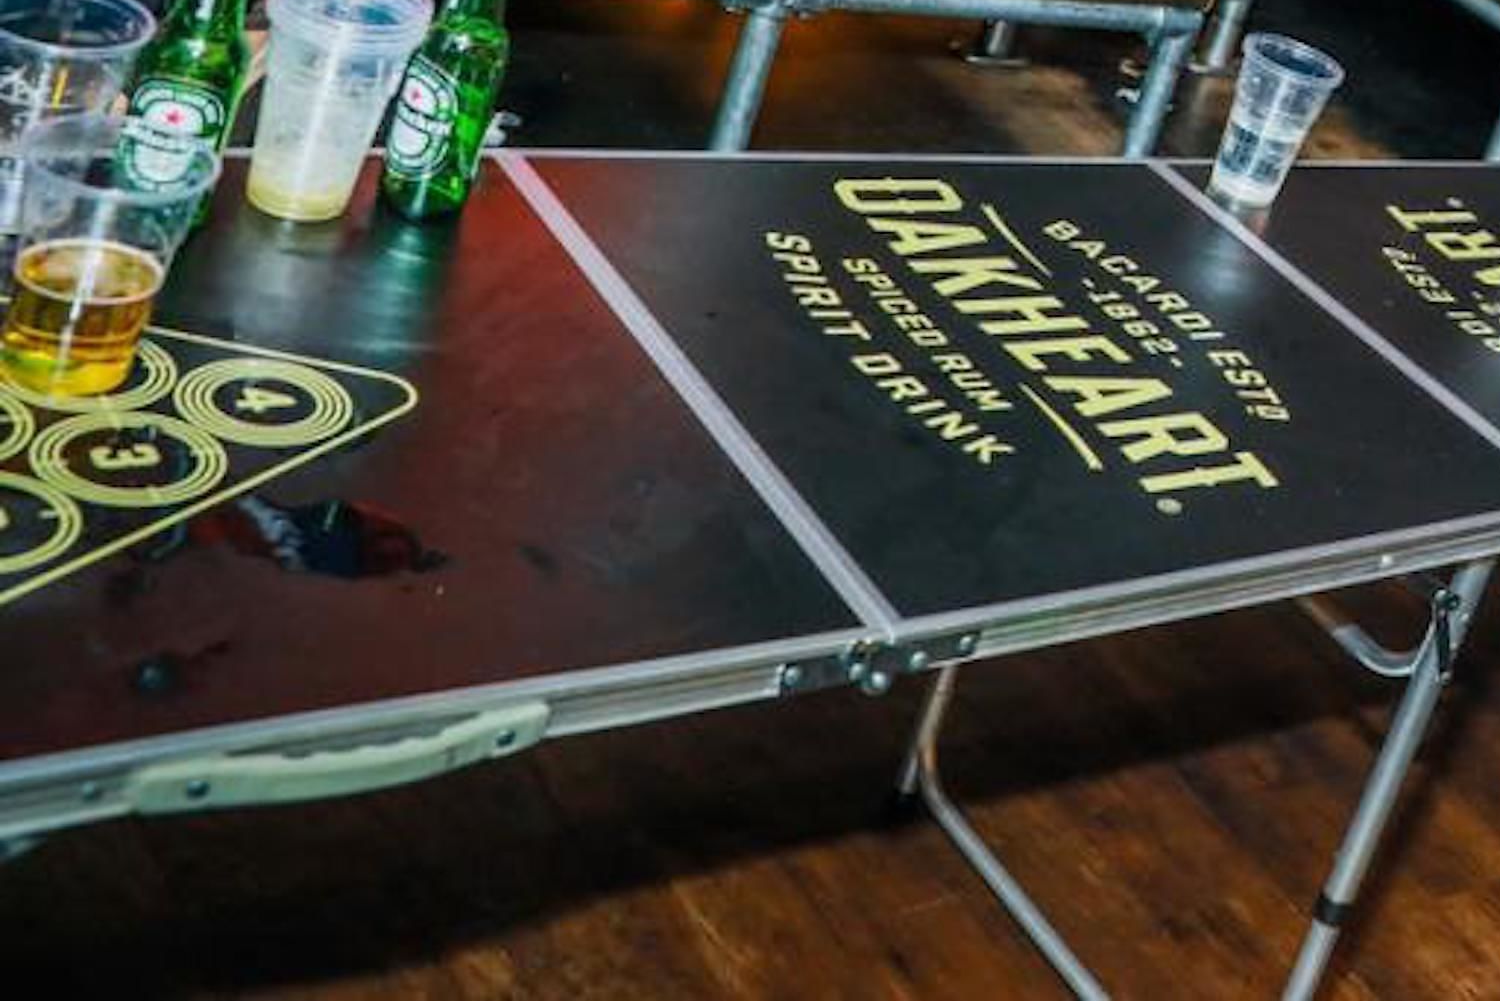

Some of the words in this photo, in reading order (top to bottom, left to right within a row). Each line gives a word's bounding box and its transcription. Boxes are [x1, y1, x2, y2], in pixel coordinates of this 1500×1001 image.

[766, 231, 873, 341] SPIRIT
[851, 352, 1016, 465] DRINK
[833, 177, 1278, 494] OAKHEART
[843, 257, 948, 348] SPICED
[931, 352, 1014, 411] RUM
[1042, 219, 1226, 341] BACARDI
[89, 442, 162, 470] 3
[235, 386, 298, 415] 4
